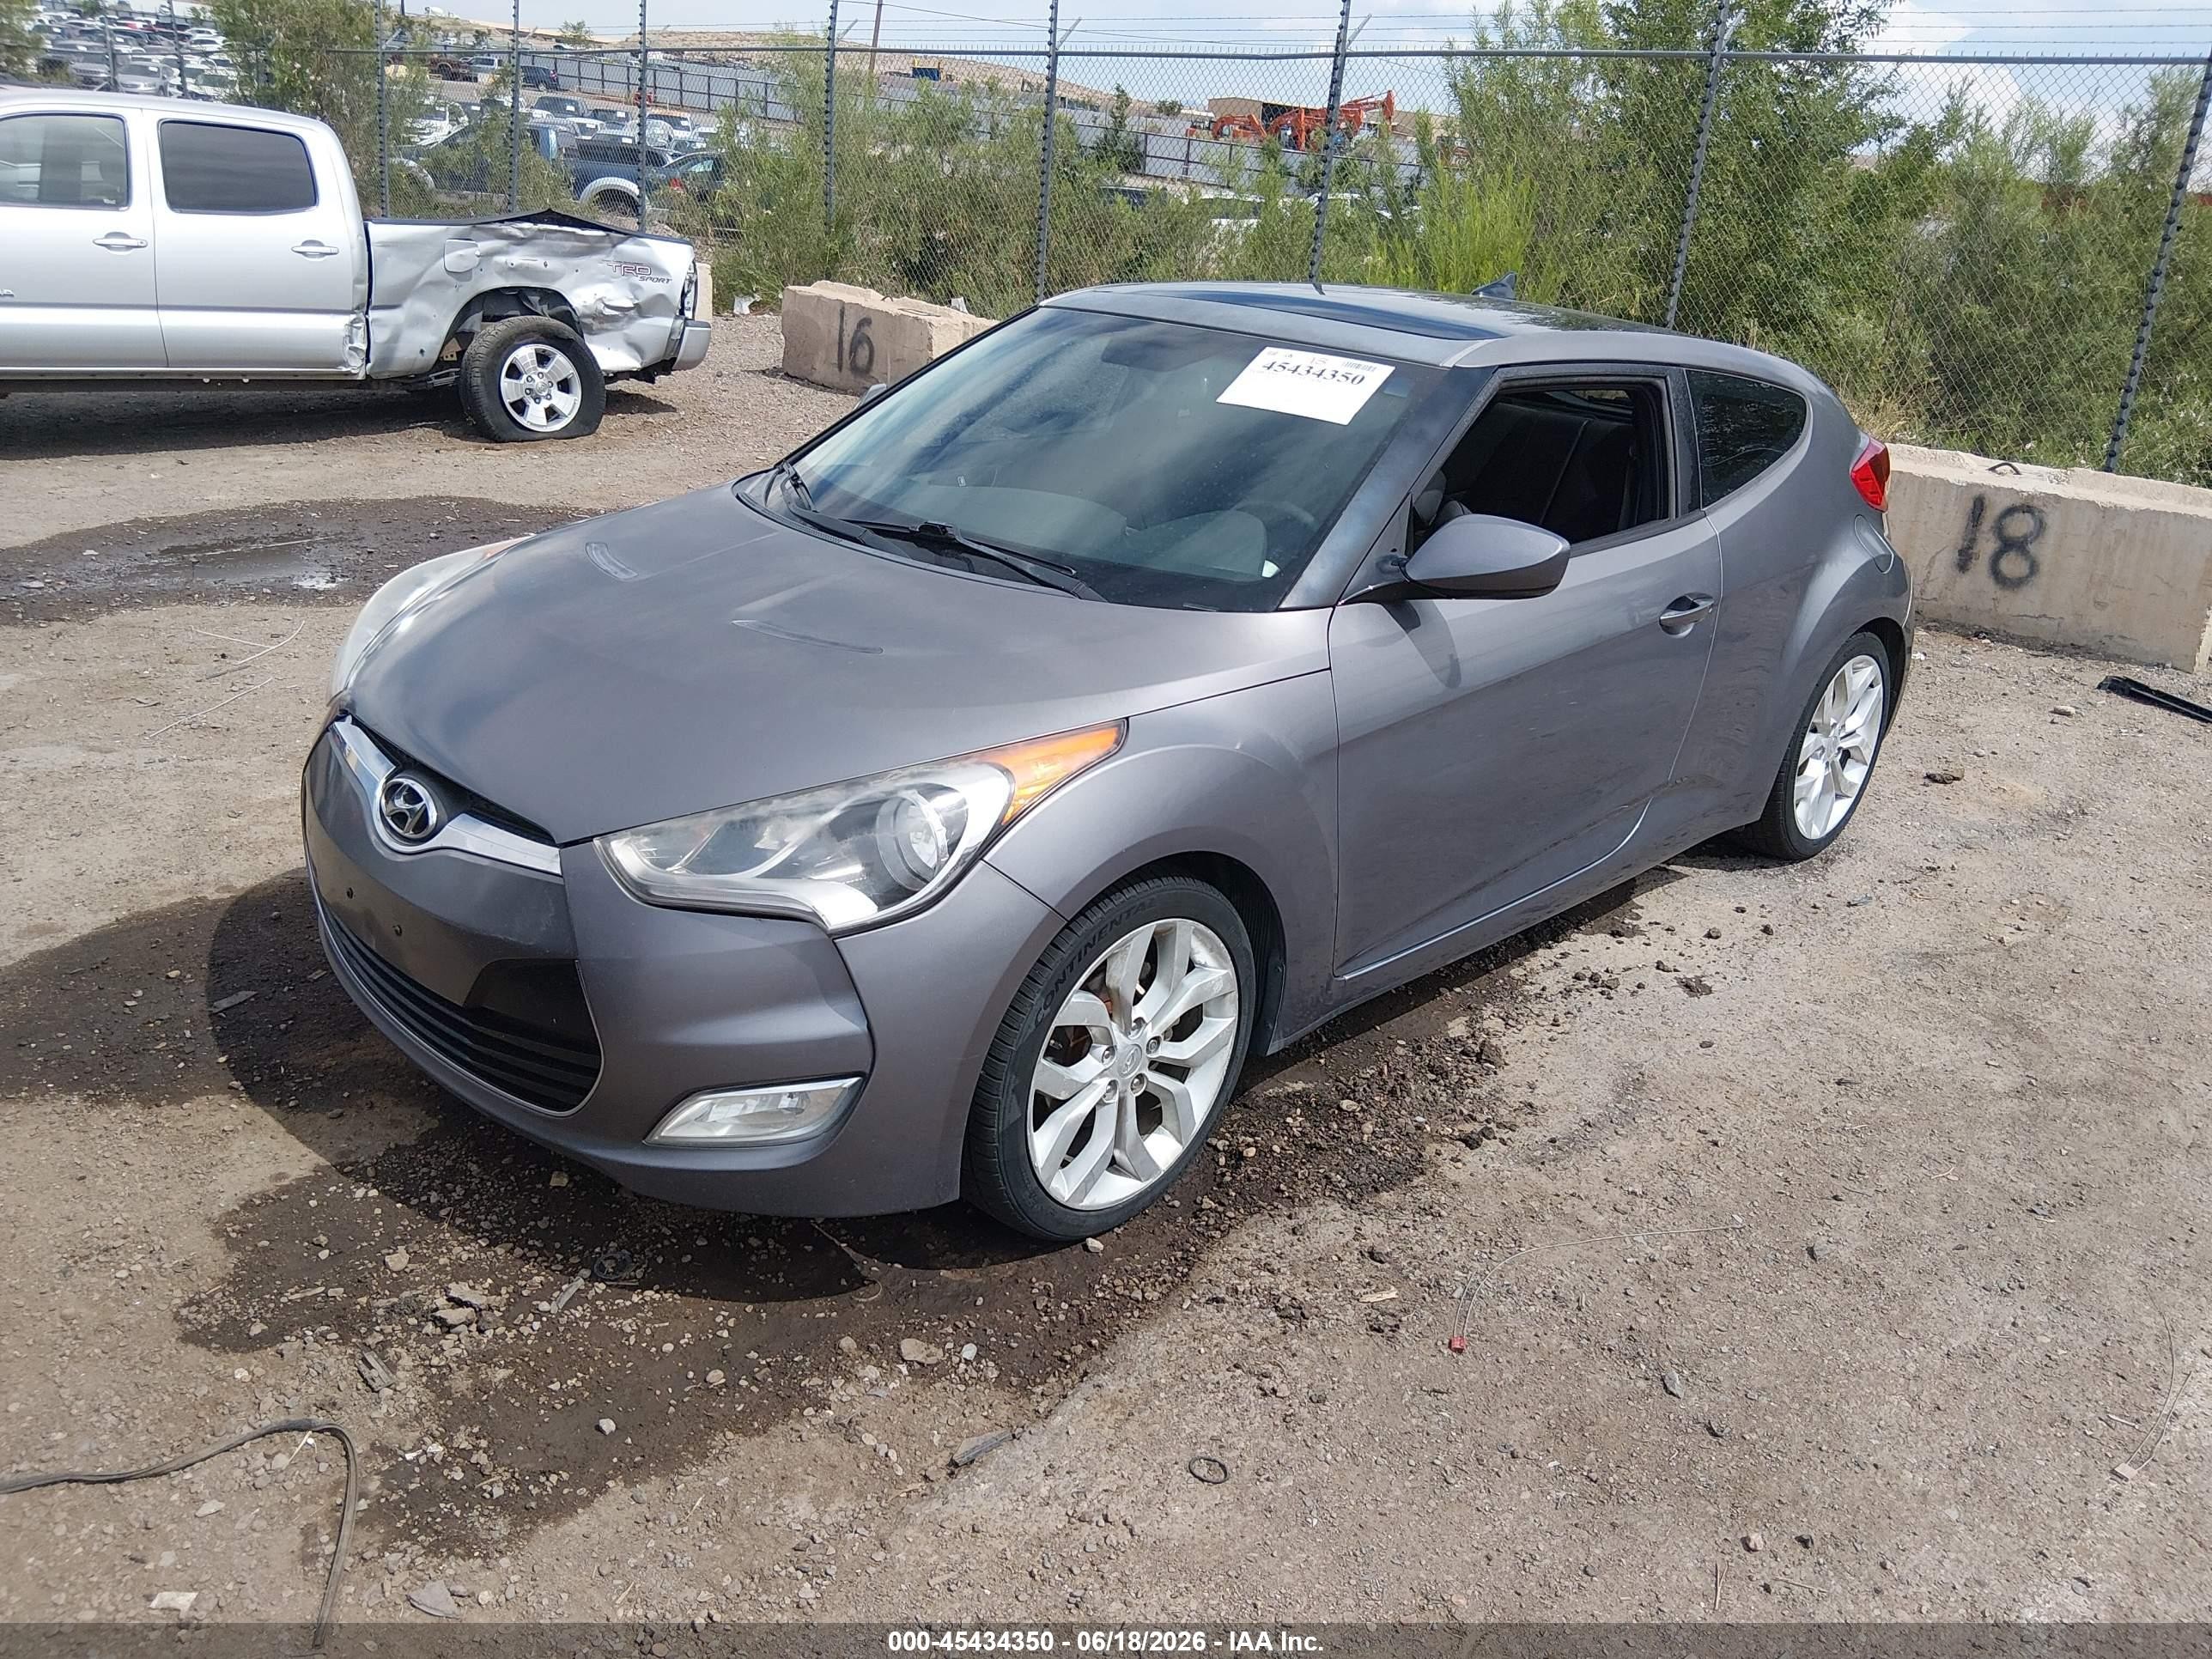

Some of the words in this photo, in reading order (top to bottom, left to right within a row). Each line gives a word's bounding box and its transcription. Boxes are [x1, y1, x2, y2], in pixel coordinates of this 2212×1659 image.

[606, 263, 652, 276] TRD
[638, 276, 673, 284] SPORT
[837, 307, 875, 376] 16
[1261, 361, 1365, 386] 45434350
[1954, 494, 2047, 590] 18
